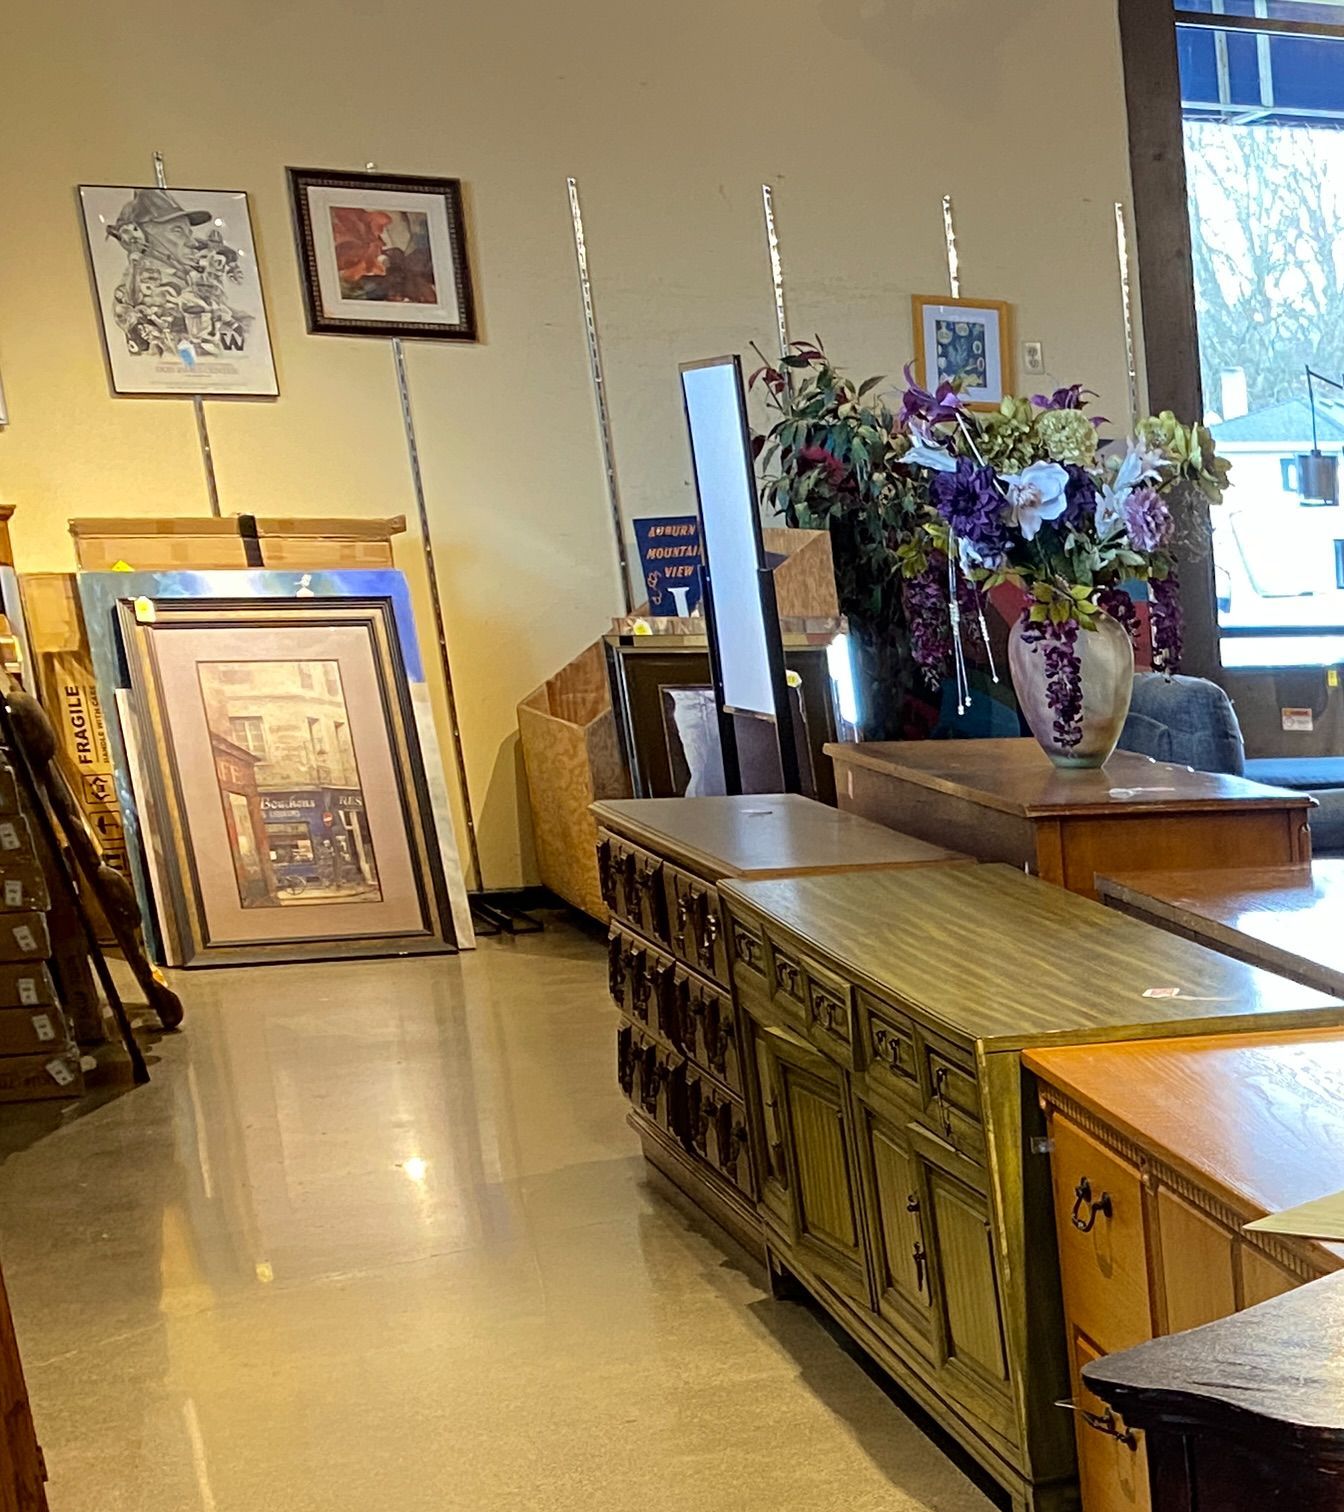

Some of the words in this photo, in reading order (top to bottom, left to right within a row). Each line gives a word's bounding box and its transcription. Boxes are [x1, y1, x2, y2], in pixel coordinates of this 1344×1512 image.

[647, 524, 696, 537] AUBURN
[646, 545, 701, 559] MOUNTAI
[664, 565, 694, 578] VIEW
[89, 685, 99, 706] CARE
[64, 685, 93, 764] FRAGILE
[94, 708, 104, 729] WITH
[98, 731, 110, 763] HANDLE
